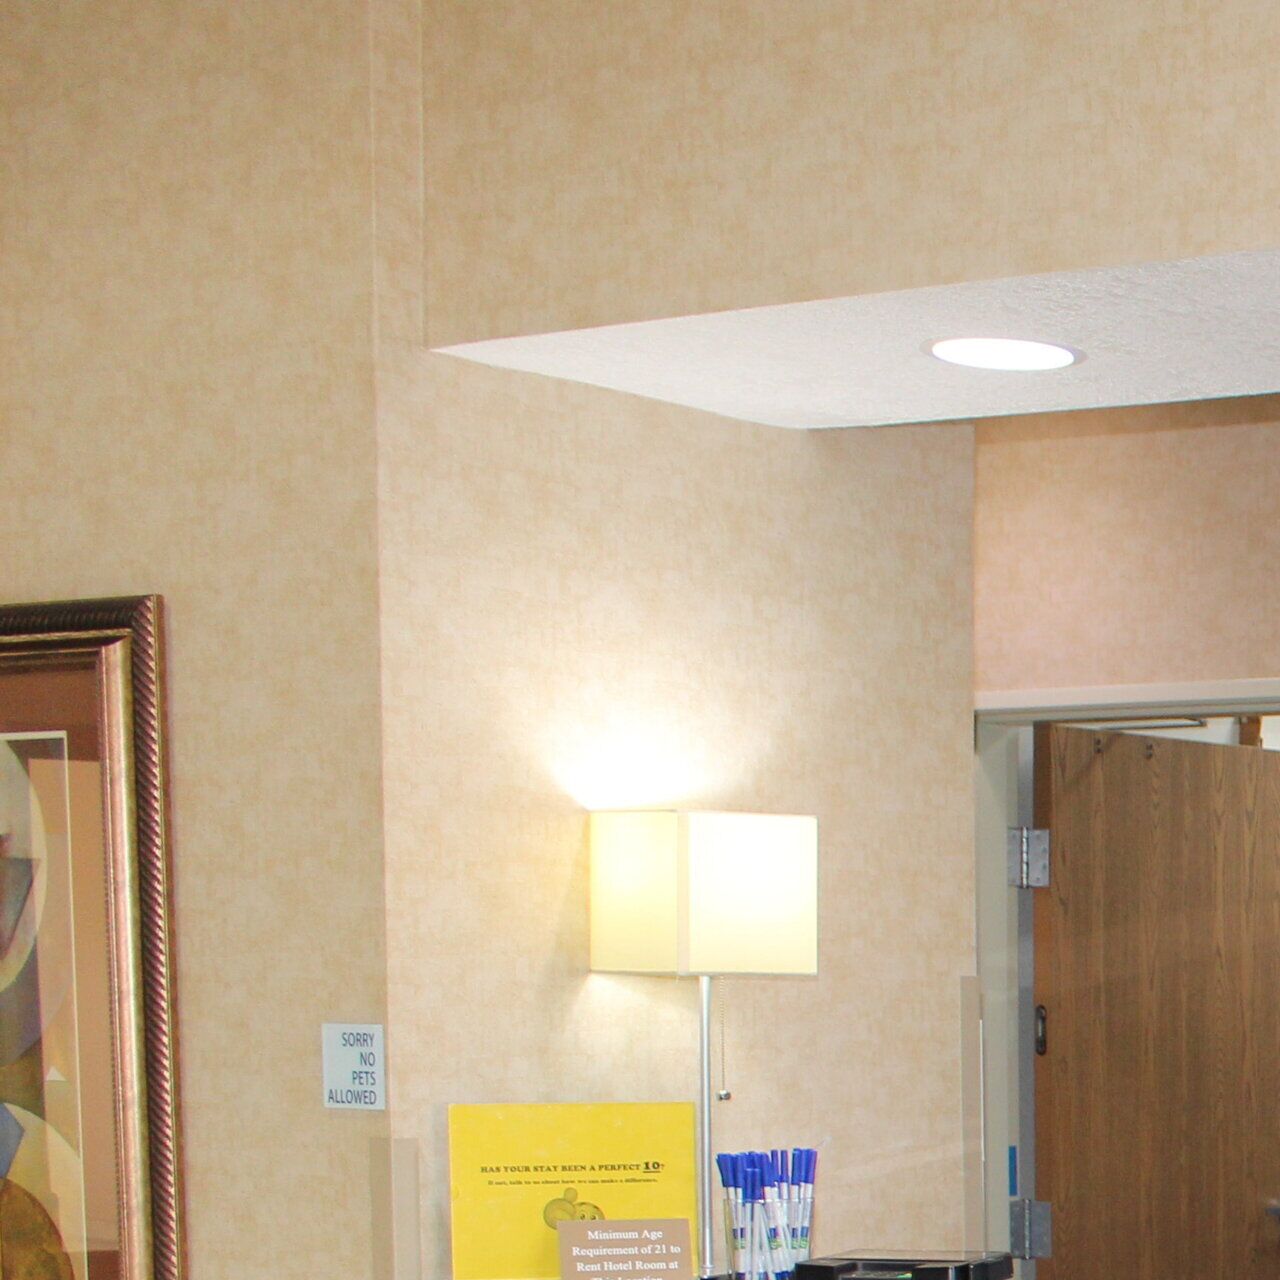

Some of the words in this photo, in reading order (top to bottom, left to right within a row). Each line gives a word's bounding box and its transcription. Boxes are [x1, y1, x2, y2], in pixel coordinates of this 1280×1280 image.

[341, 1032, 375, 1047] SORRY
[360, 1052, 376, 1067] NO
[352, 1071, 376, 1086] PETS
[327, 1089, 377, 1105] ALLOWED
[480, 1165, 502, 1173] HAS
[503, 1165, 531, 1173] YOUR
[532, 1164, 558, 1172] STAY
[561, 1164, 587, 1172] BEEN
[598, 1163, 640, 1172] PERFECT
[587, 1230, 639, 1240] Minimum
[641, 1229, 663, 1241] Age
[572, 1245, 639, 1257] Requirement
[640, 1244, 653, 1254] of
[655, 1244, 666, 1254] 21
[670, 1244, 681, 1254] to
[576, 1261, 601, 1272] Rent
[603, 1260, 632, 1271] Hotel
[635, 1260, 667, 1270] Room
[668, 1260, 679, 1269] at
